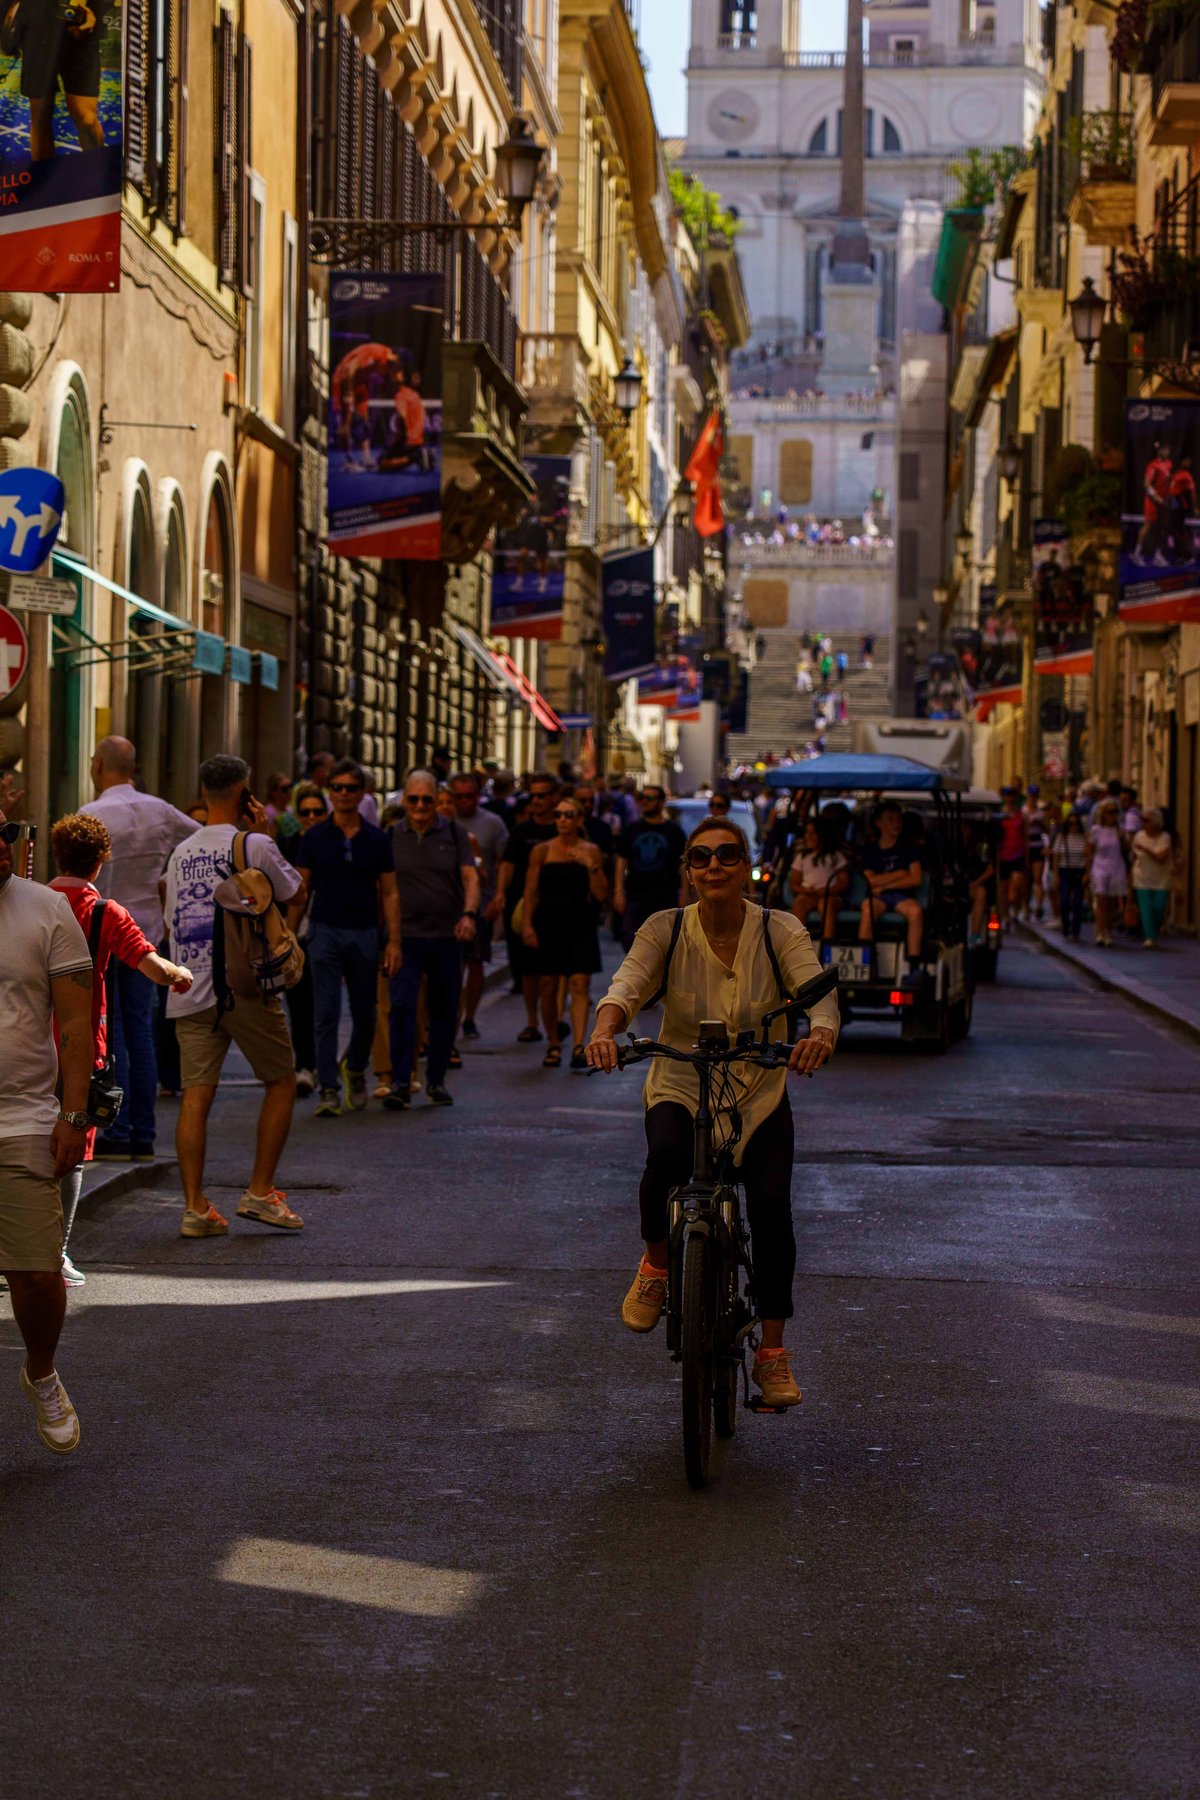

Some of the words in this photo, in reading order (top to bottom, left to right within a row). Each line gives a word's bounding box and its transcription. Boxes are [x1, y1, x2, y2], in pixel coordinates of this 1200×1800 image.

[0, 191, 20, 207] IA
[68, 252, 101, 263] ROMA
[175, 850, 231, 872] Celestial
